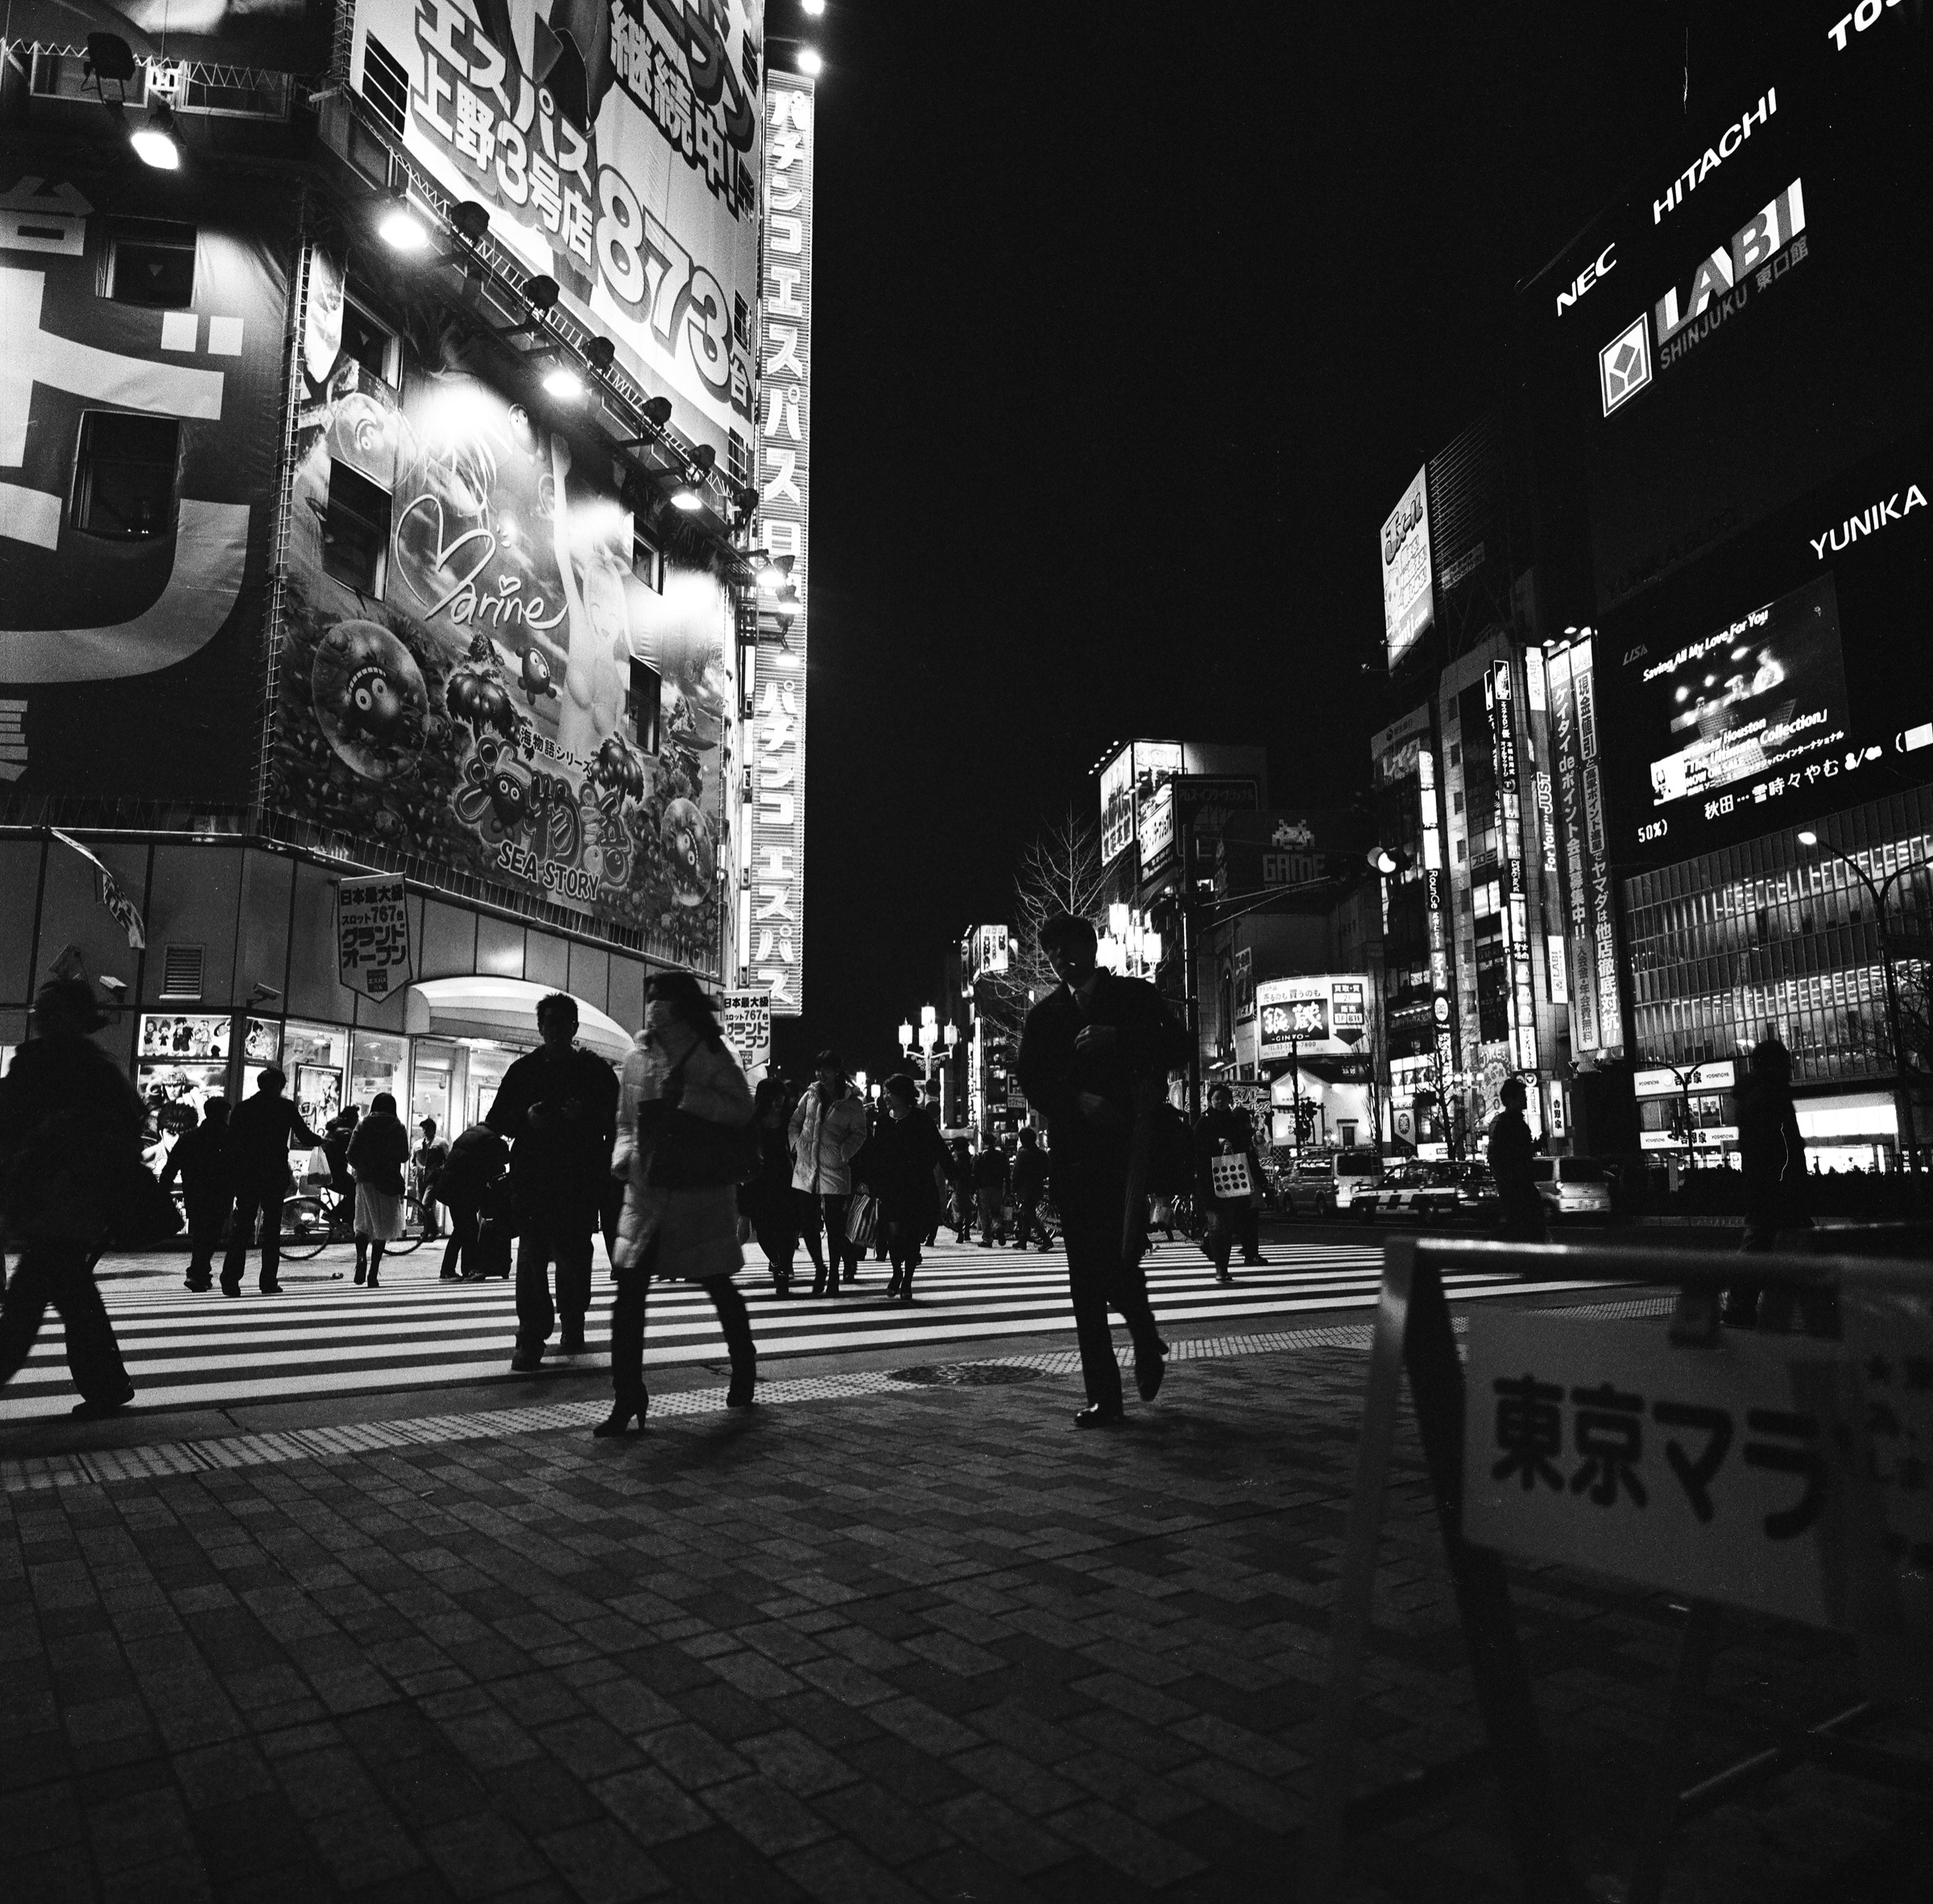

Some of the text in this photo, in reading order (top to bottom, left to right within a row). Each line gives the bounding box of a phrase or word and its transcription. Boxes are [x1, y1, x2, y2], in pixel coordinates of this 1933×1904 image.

[419, 0, 592, 198] エスパス
[611, 0, 735, 209] 継続中!
[414, 52, 593, 267] 上野3号店
[1653, 86, 1777, 225] HITACHI
[1556, 242, 1616, 317] NEC
[1654, 176, 1806, 347] LABI
[1660, 235, 1809, 370] SHINJUKU 東口館
[1810, 484, 1927, 560] YUNIKA
[1643, 610, 1768, 682] Saving All My Love For You
[519, 727, 593, 777] 海物語シリーズ
[1683, 718, 1766, 760] Whitney Houston
[1710, 738, 1758, 764] Ultimate
[1686, 756, 1745, 787] NOW ON SALE
[1537, 771, 1557, 872] For Your JUST
[498, 842, 600, 900] SEA STORY
[1262, 853, 1326, 882] GAME
[341, 884, 404, 906] 日本最大級
[341, 923, 405, 949] グランド
[342, 946, 407, 969] オープン
[1551, 950, 1559, 978] LABI
[724, 996, 769, 1008] 日本最大級
[1264, 989, 1321, 1003] 売るのも買うのも
[727, 1021, 769, 1036] グランド
[1554, 1099, 1563, 1129] 吉野家
[1492, 1373, 1826, 1542] 東京マラ
